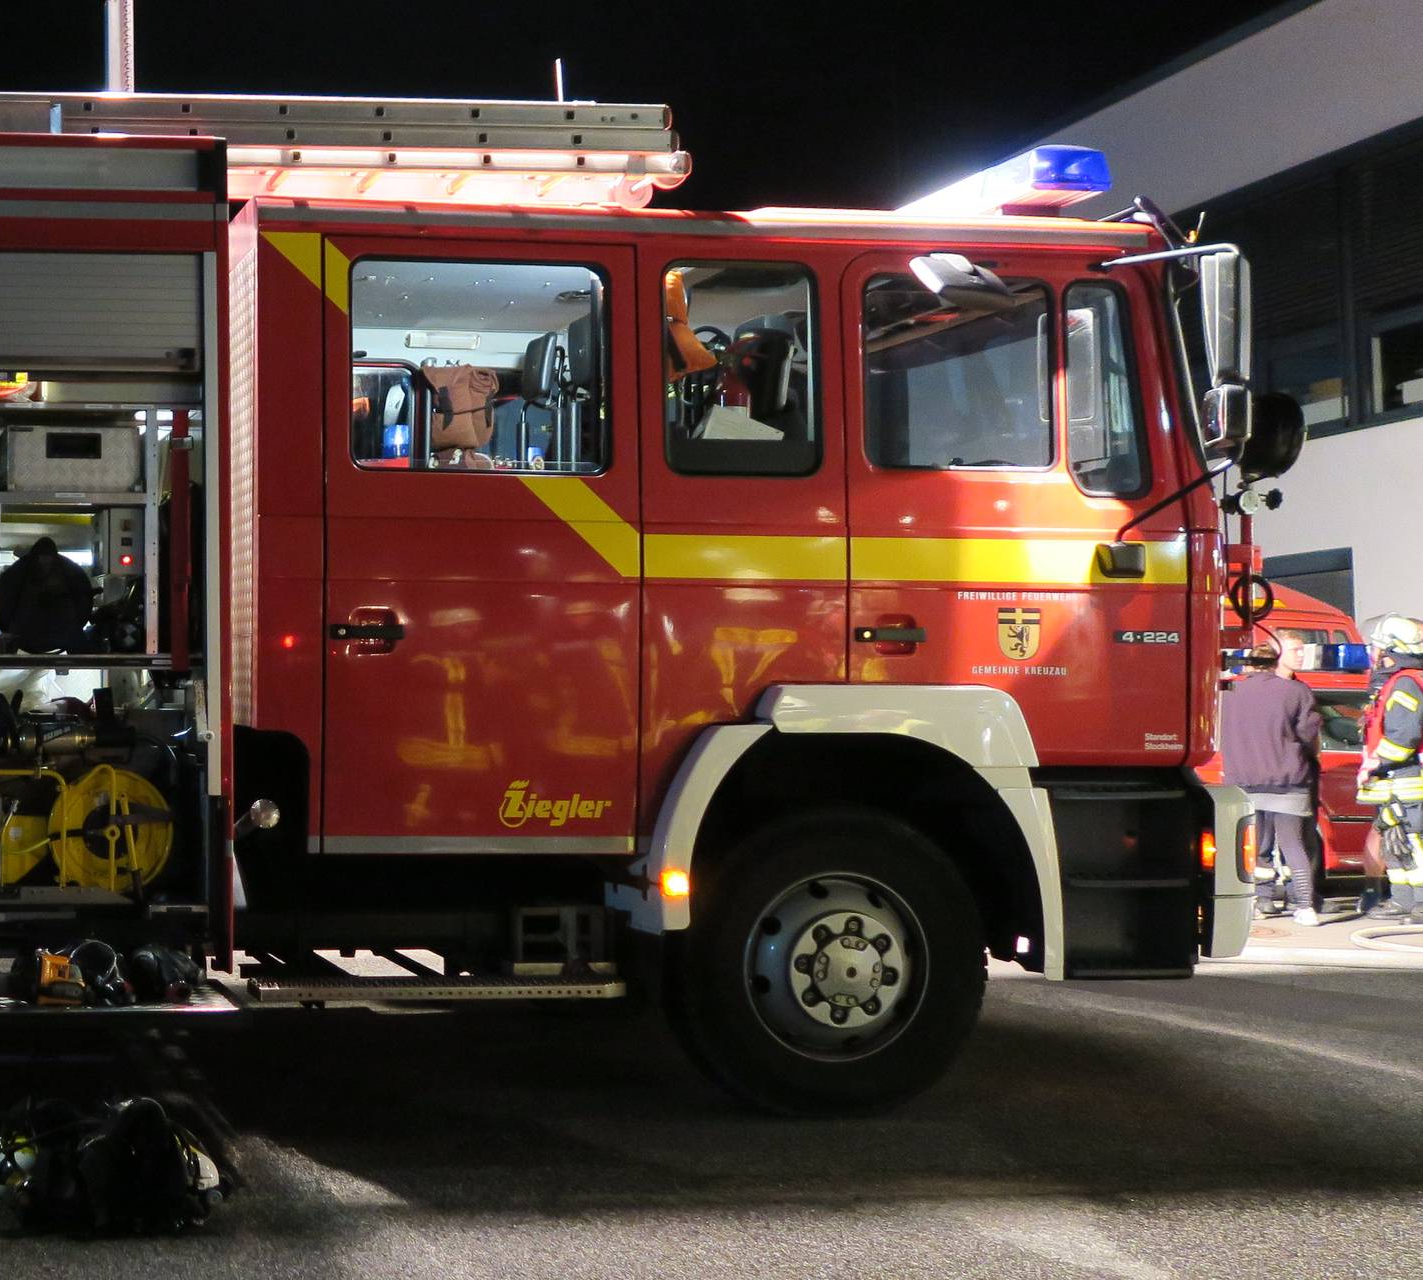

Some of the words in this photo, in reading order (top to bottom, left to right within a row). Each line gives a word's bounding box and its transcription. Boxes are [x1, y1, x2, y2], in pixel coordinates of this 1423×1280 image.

[956, 591, 1017, 601] FREIWILLIGE
[971, 665, 1020, 676] GEMEINDE
[1024, 665, 1068, 676] KREUZAU
[498, 779, 614, 828] Ziegler
